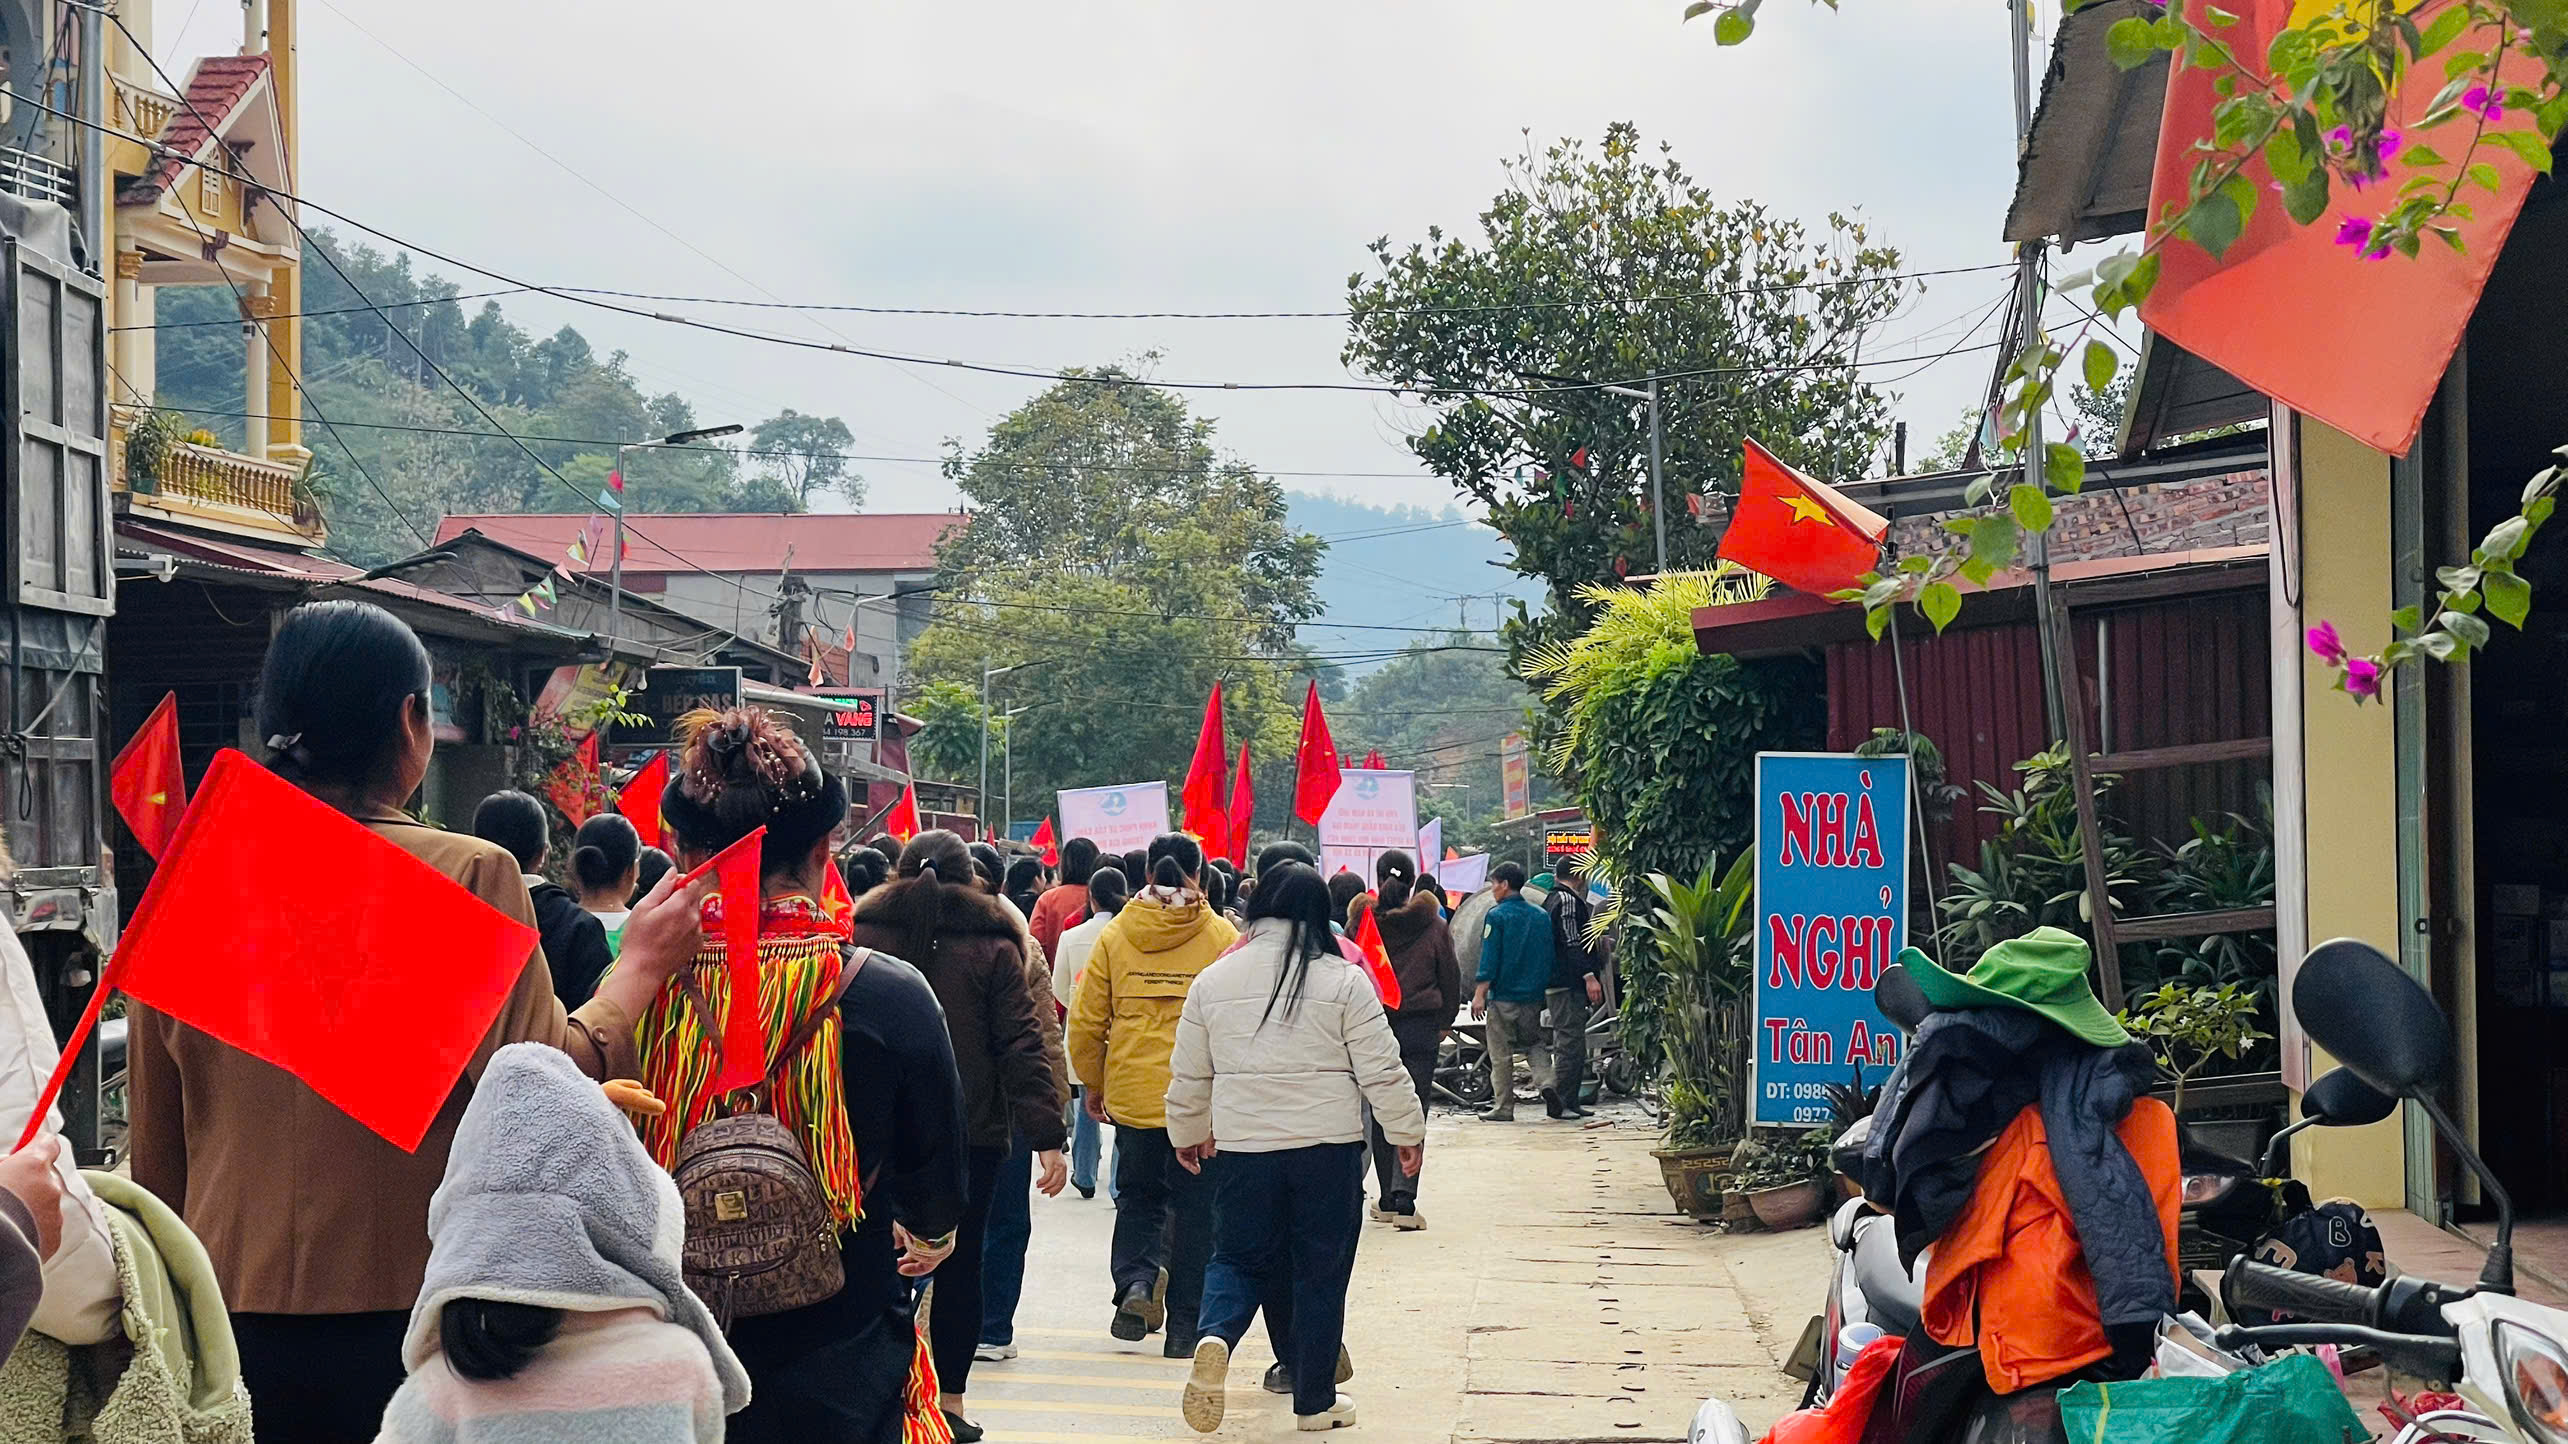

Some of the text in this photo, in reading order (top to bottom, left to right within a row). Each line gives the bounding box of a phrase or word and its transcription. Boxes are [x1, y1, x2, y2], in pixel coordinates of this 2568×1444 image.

[1780, 770, 1884, 868] NHÀ
[1769, 885, 1895, 991] NGHỈ
[1764, 1017, 1897, 1066] Tân An
[1766, 1082, 1790, 1099] ĐT:
[2328, 1215, 2352, 1248] B
